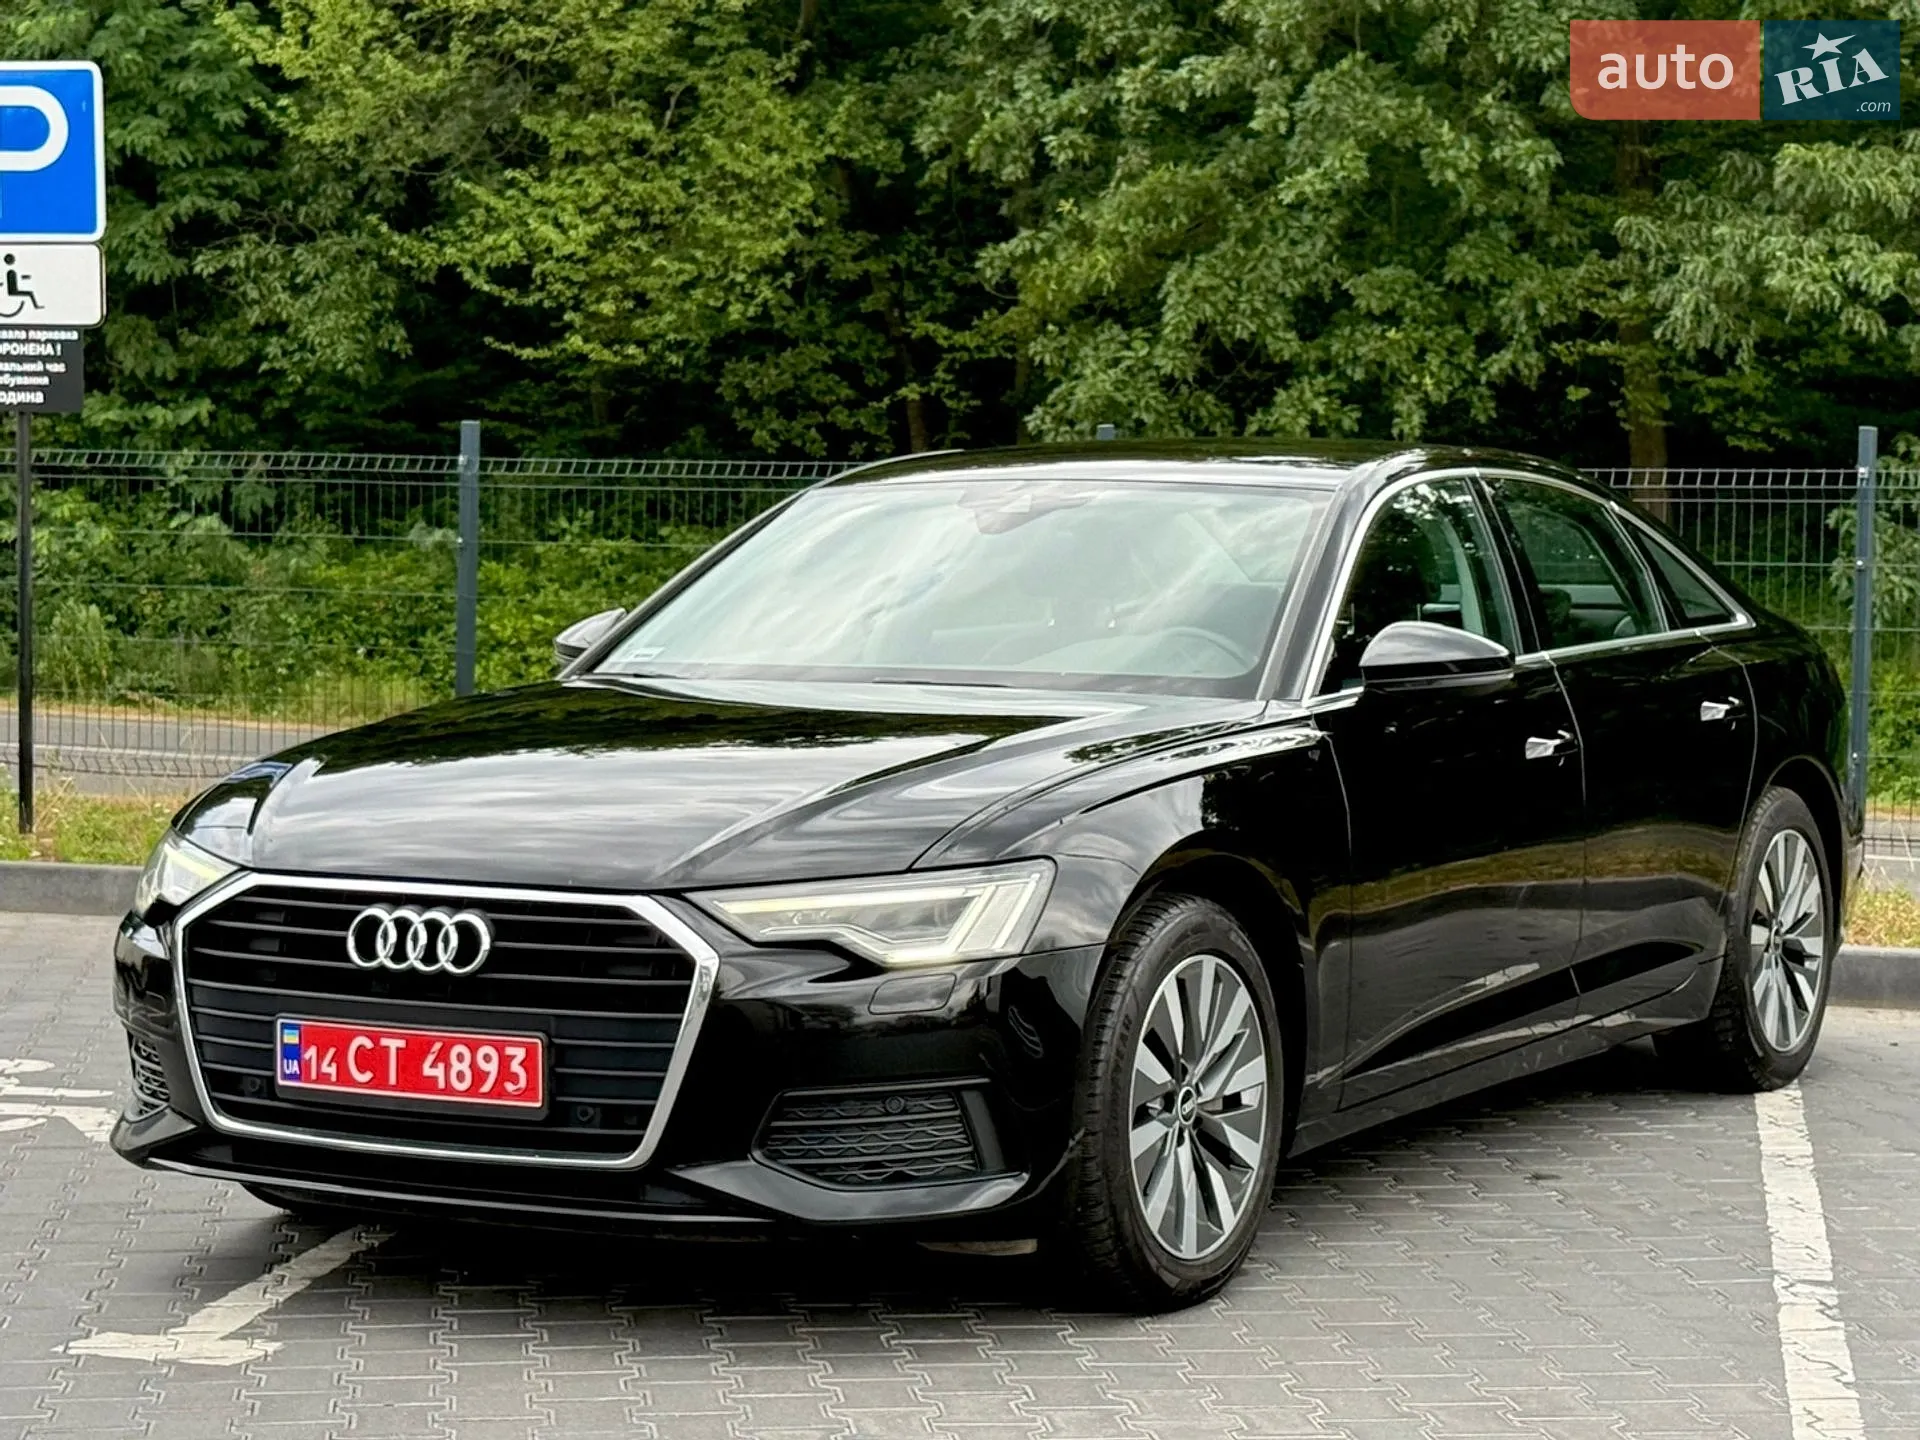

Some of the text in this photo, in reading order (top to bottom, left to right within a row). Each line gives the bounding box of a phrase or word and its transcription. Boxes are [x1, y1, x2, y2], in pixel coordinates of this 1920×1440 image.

[0, 343, 54, 355] РОНЕНА
[283, 1059, 300, 1075] UA
[422, 1041, 527, 1095] 4893
